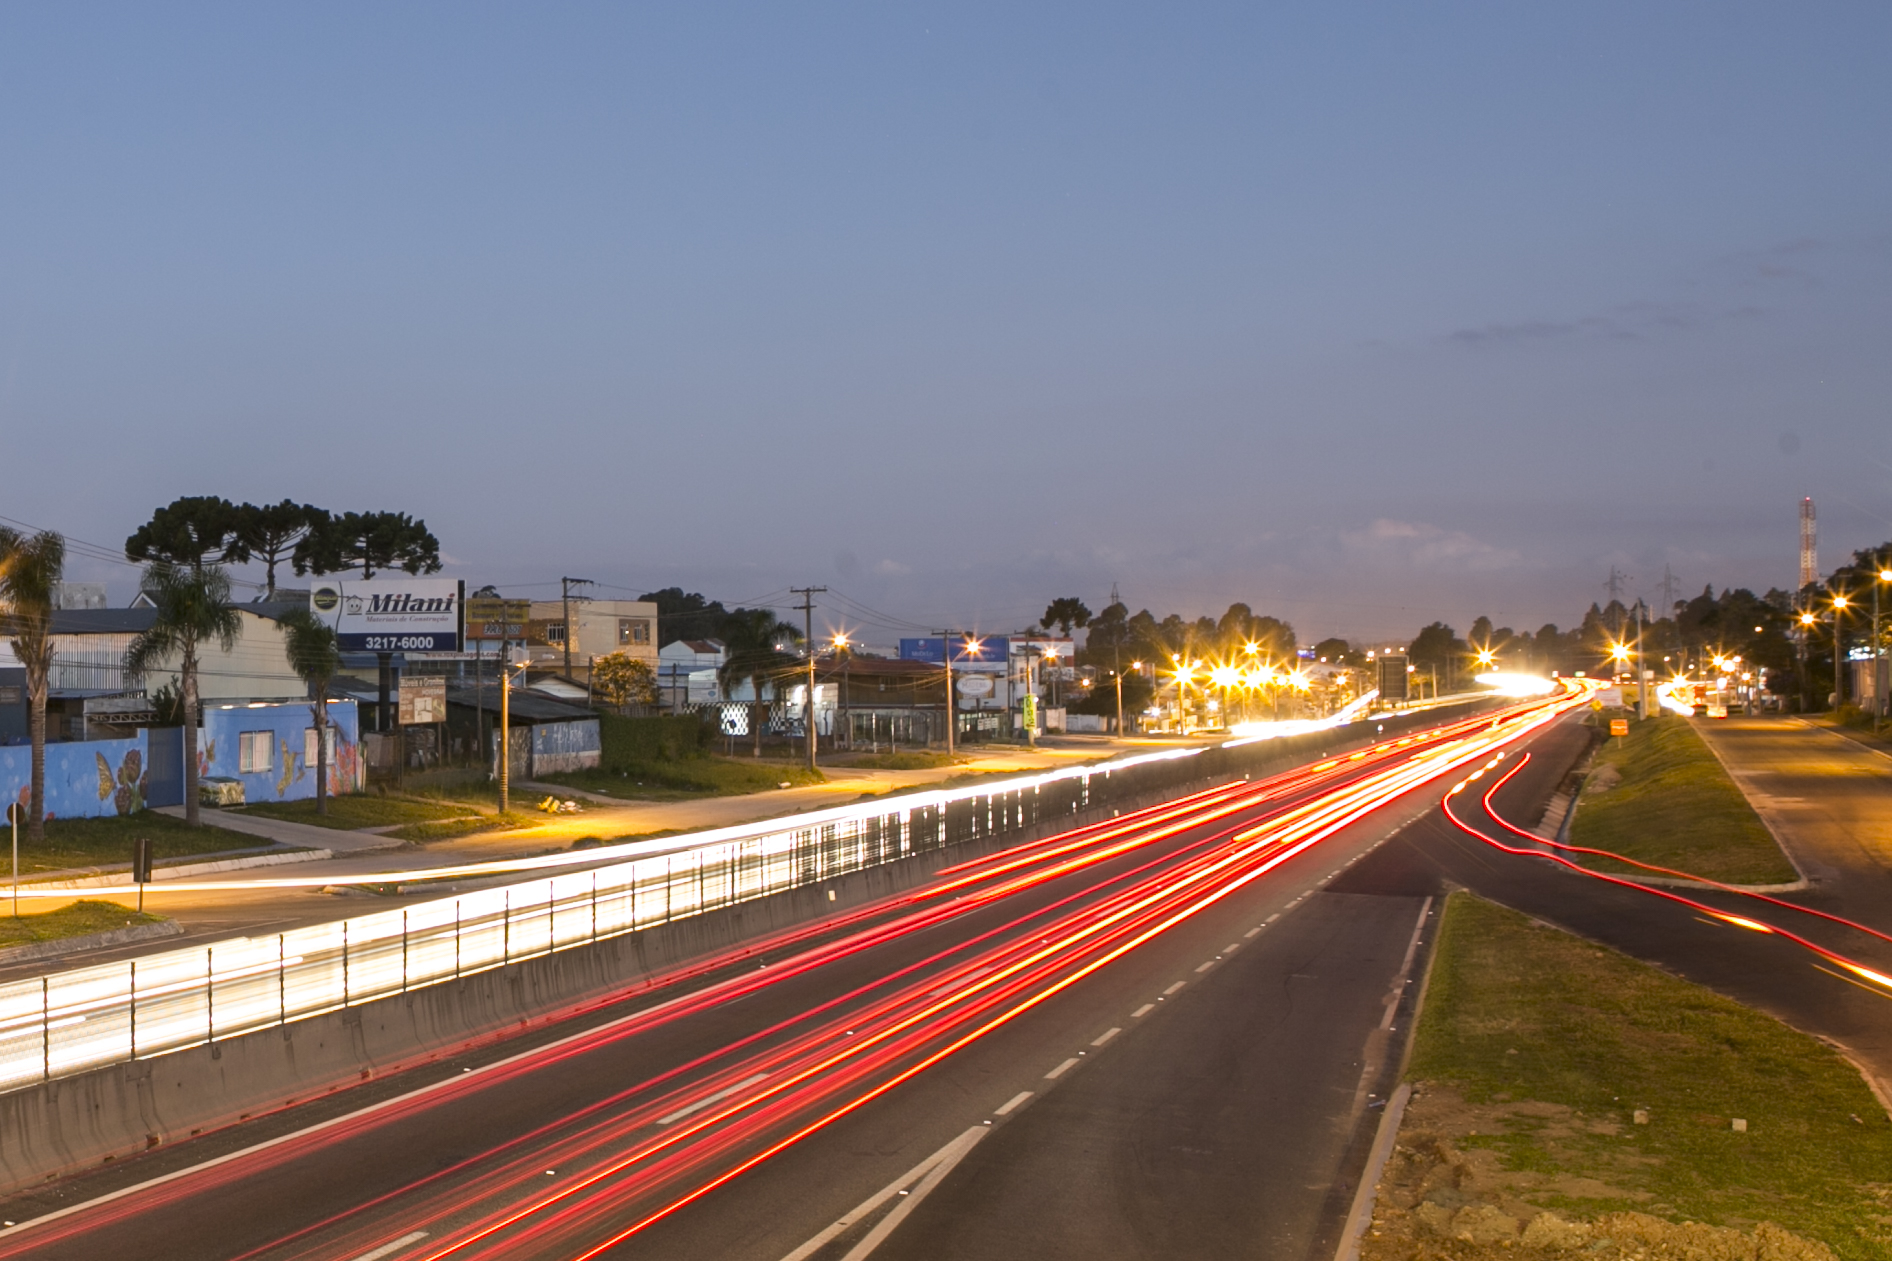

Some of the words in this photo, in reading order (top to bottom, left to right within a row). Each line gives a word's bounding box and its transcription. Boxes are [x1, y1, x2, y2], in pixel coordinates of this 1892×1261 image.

[366, 593, 455, 612] Milani
[409, 614, 449, 623] Construção
[365, 636, 434, 649] 3217-6000
